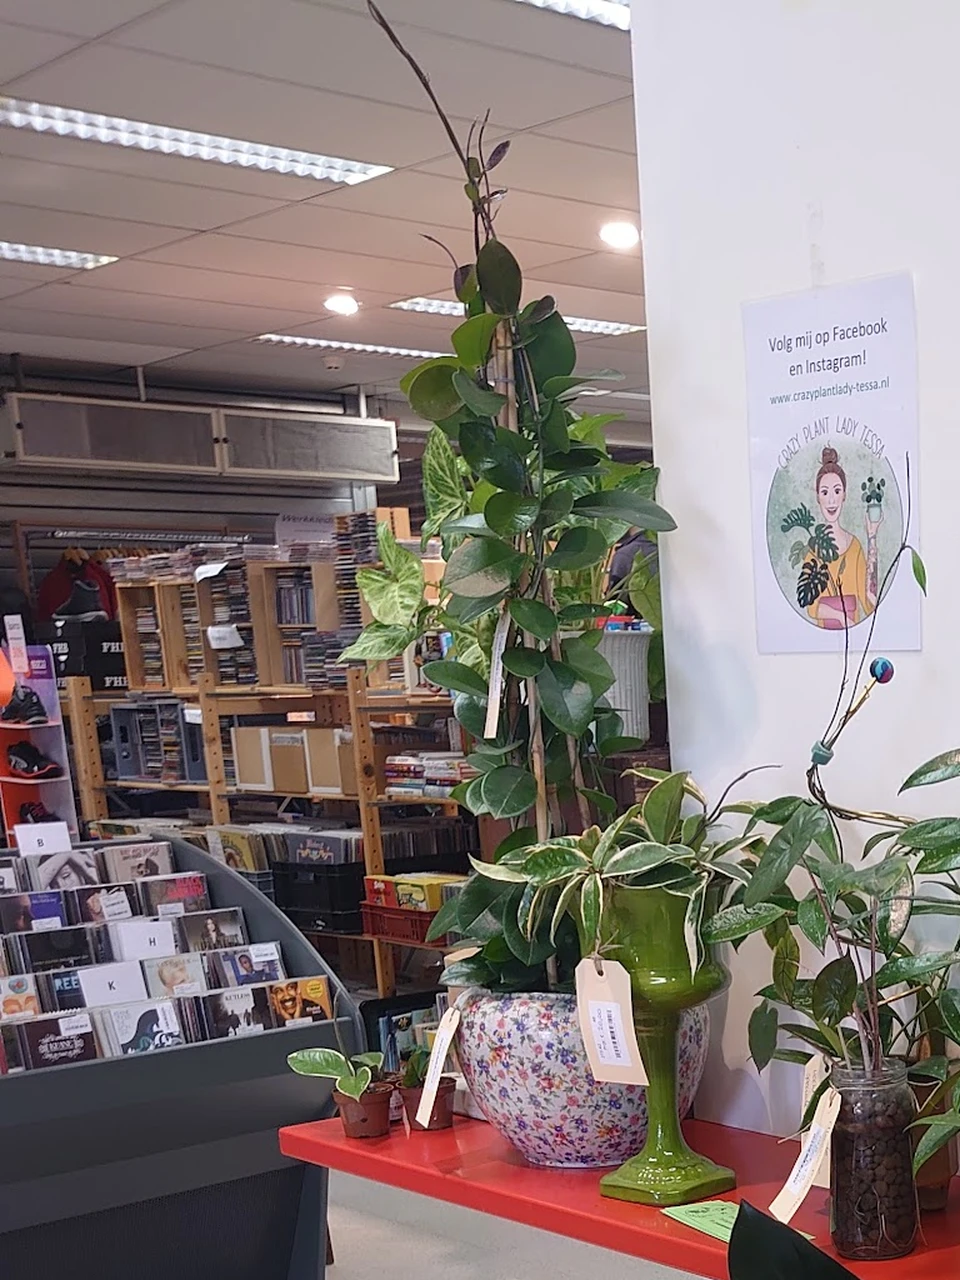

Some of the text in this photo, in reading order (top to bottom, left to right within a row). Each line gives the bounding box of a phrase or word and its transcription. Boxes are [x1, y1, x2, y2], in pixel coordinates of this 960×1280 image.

[768, 317, 888, 353] Volg mij op Facebook
[789, 350, 867, 376] en Instagram!
[769, 376, 890, 405] www.crazyplantlady-tessa.nl
[778, 415, 885, 469] CRAZY PLANT LADY TESSA
[36, 838, 45, 847] B
[148, 937, 157, 946] H
[107, 981, 116, 991] K
